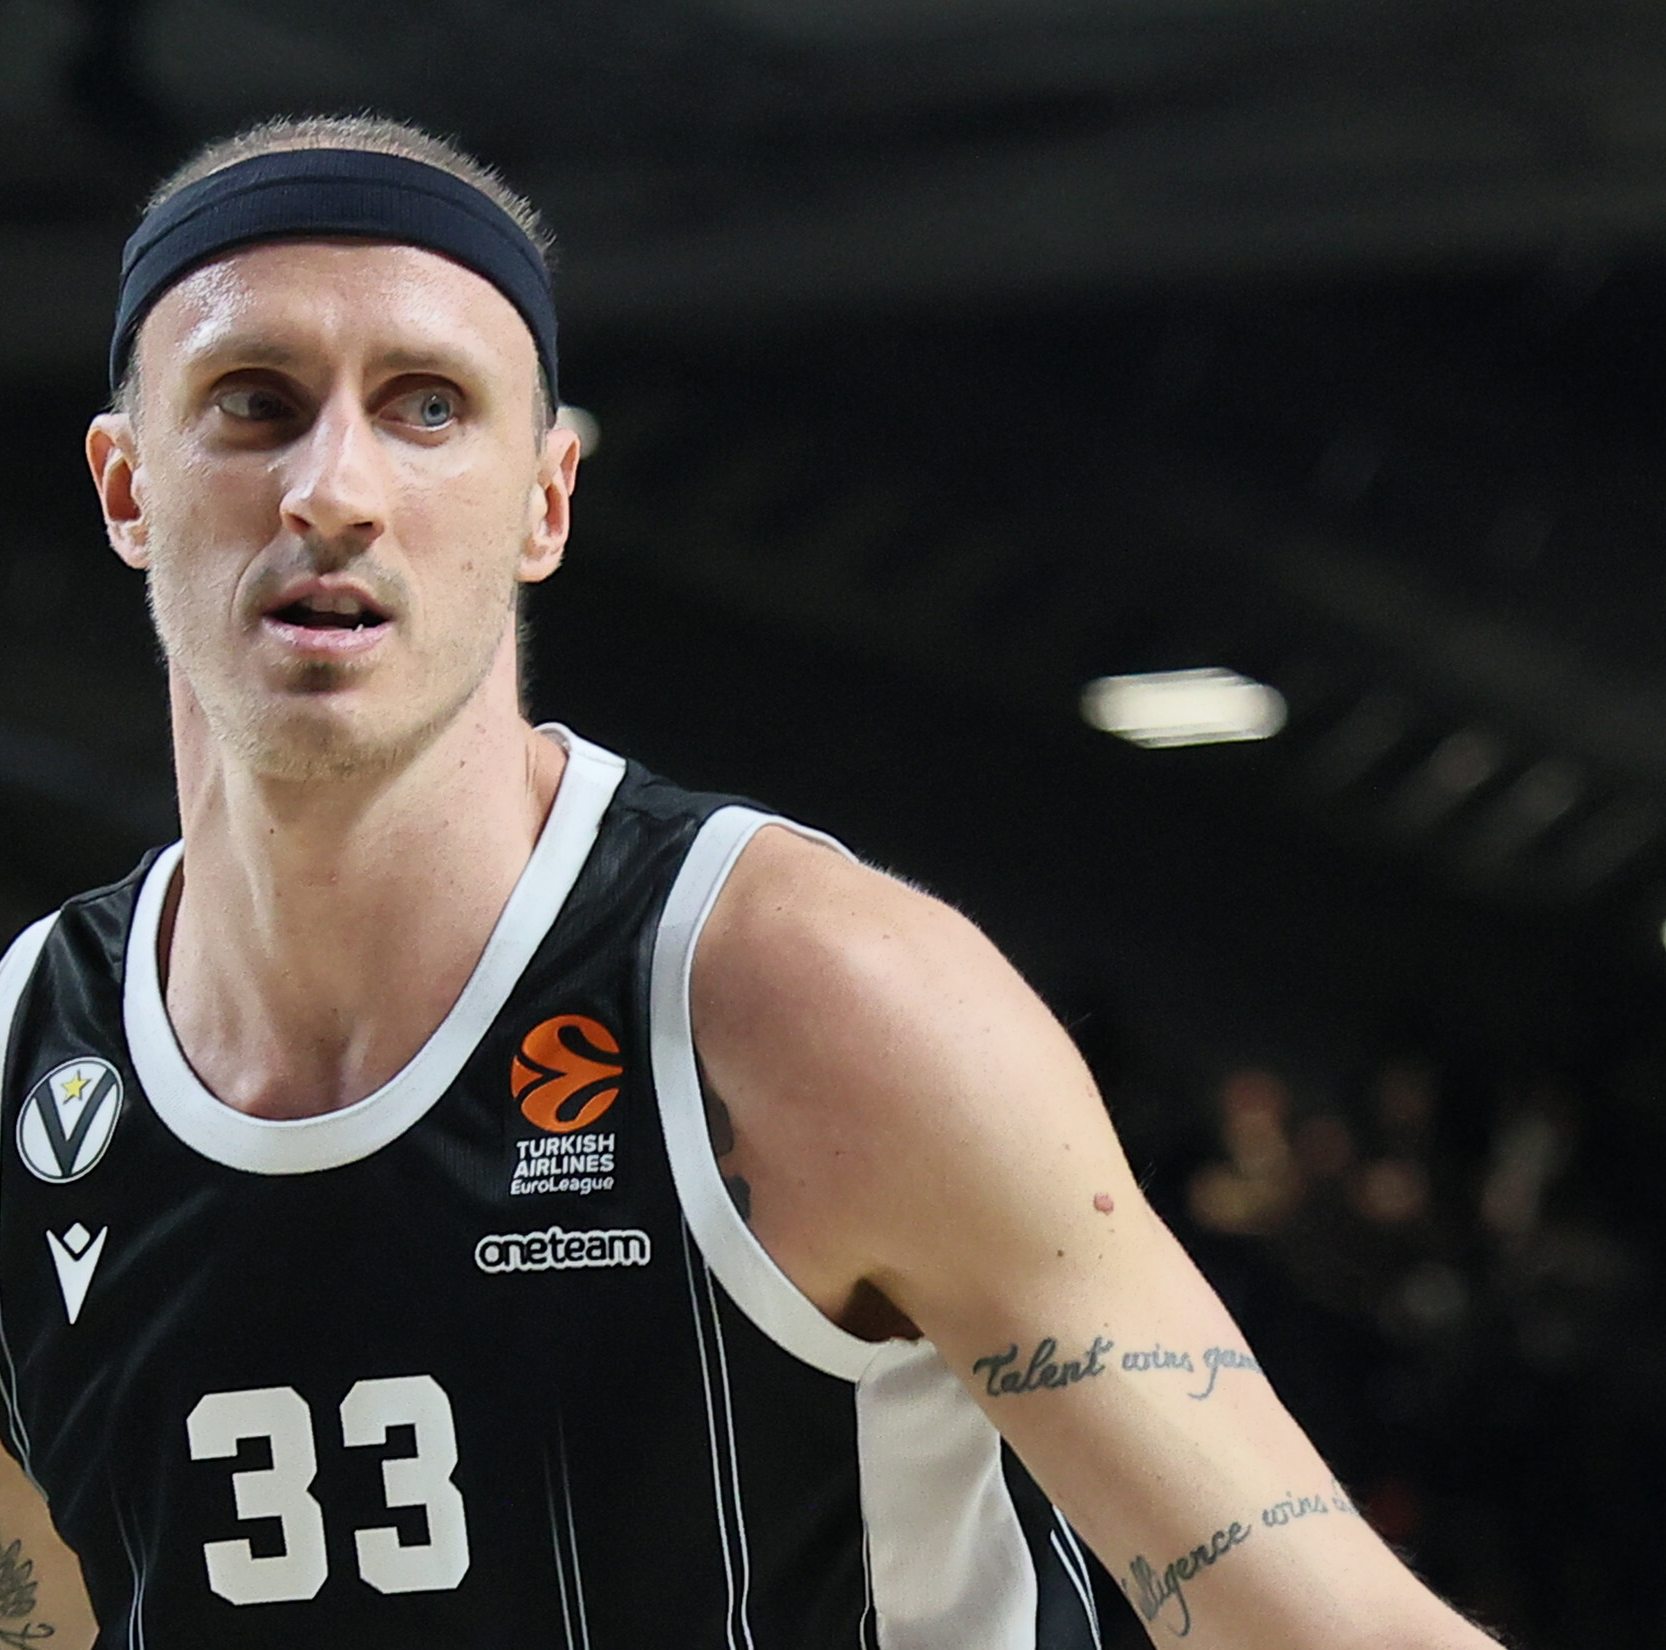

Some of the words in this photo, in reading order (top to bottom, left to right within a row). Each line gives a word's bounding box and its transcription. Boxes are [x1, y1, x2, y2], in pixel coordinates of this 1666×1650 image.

[516, 1133, 616, 1160] TURKISH
[513, 1153, 616, 1179] AIRLINES
[510, 1176, 616, 1196] EuroLeague
[476, 1227, 650, 1272] oneteam
[973, 1336, 1114, 1397] Talent
[186, 1374, 471, 1606] 33
